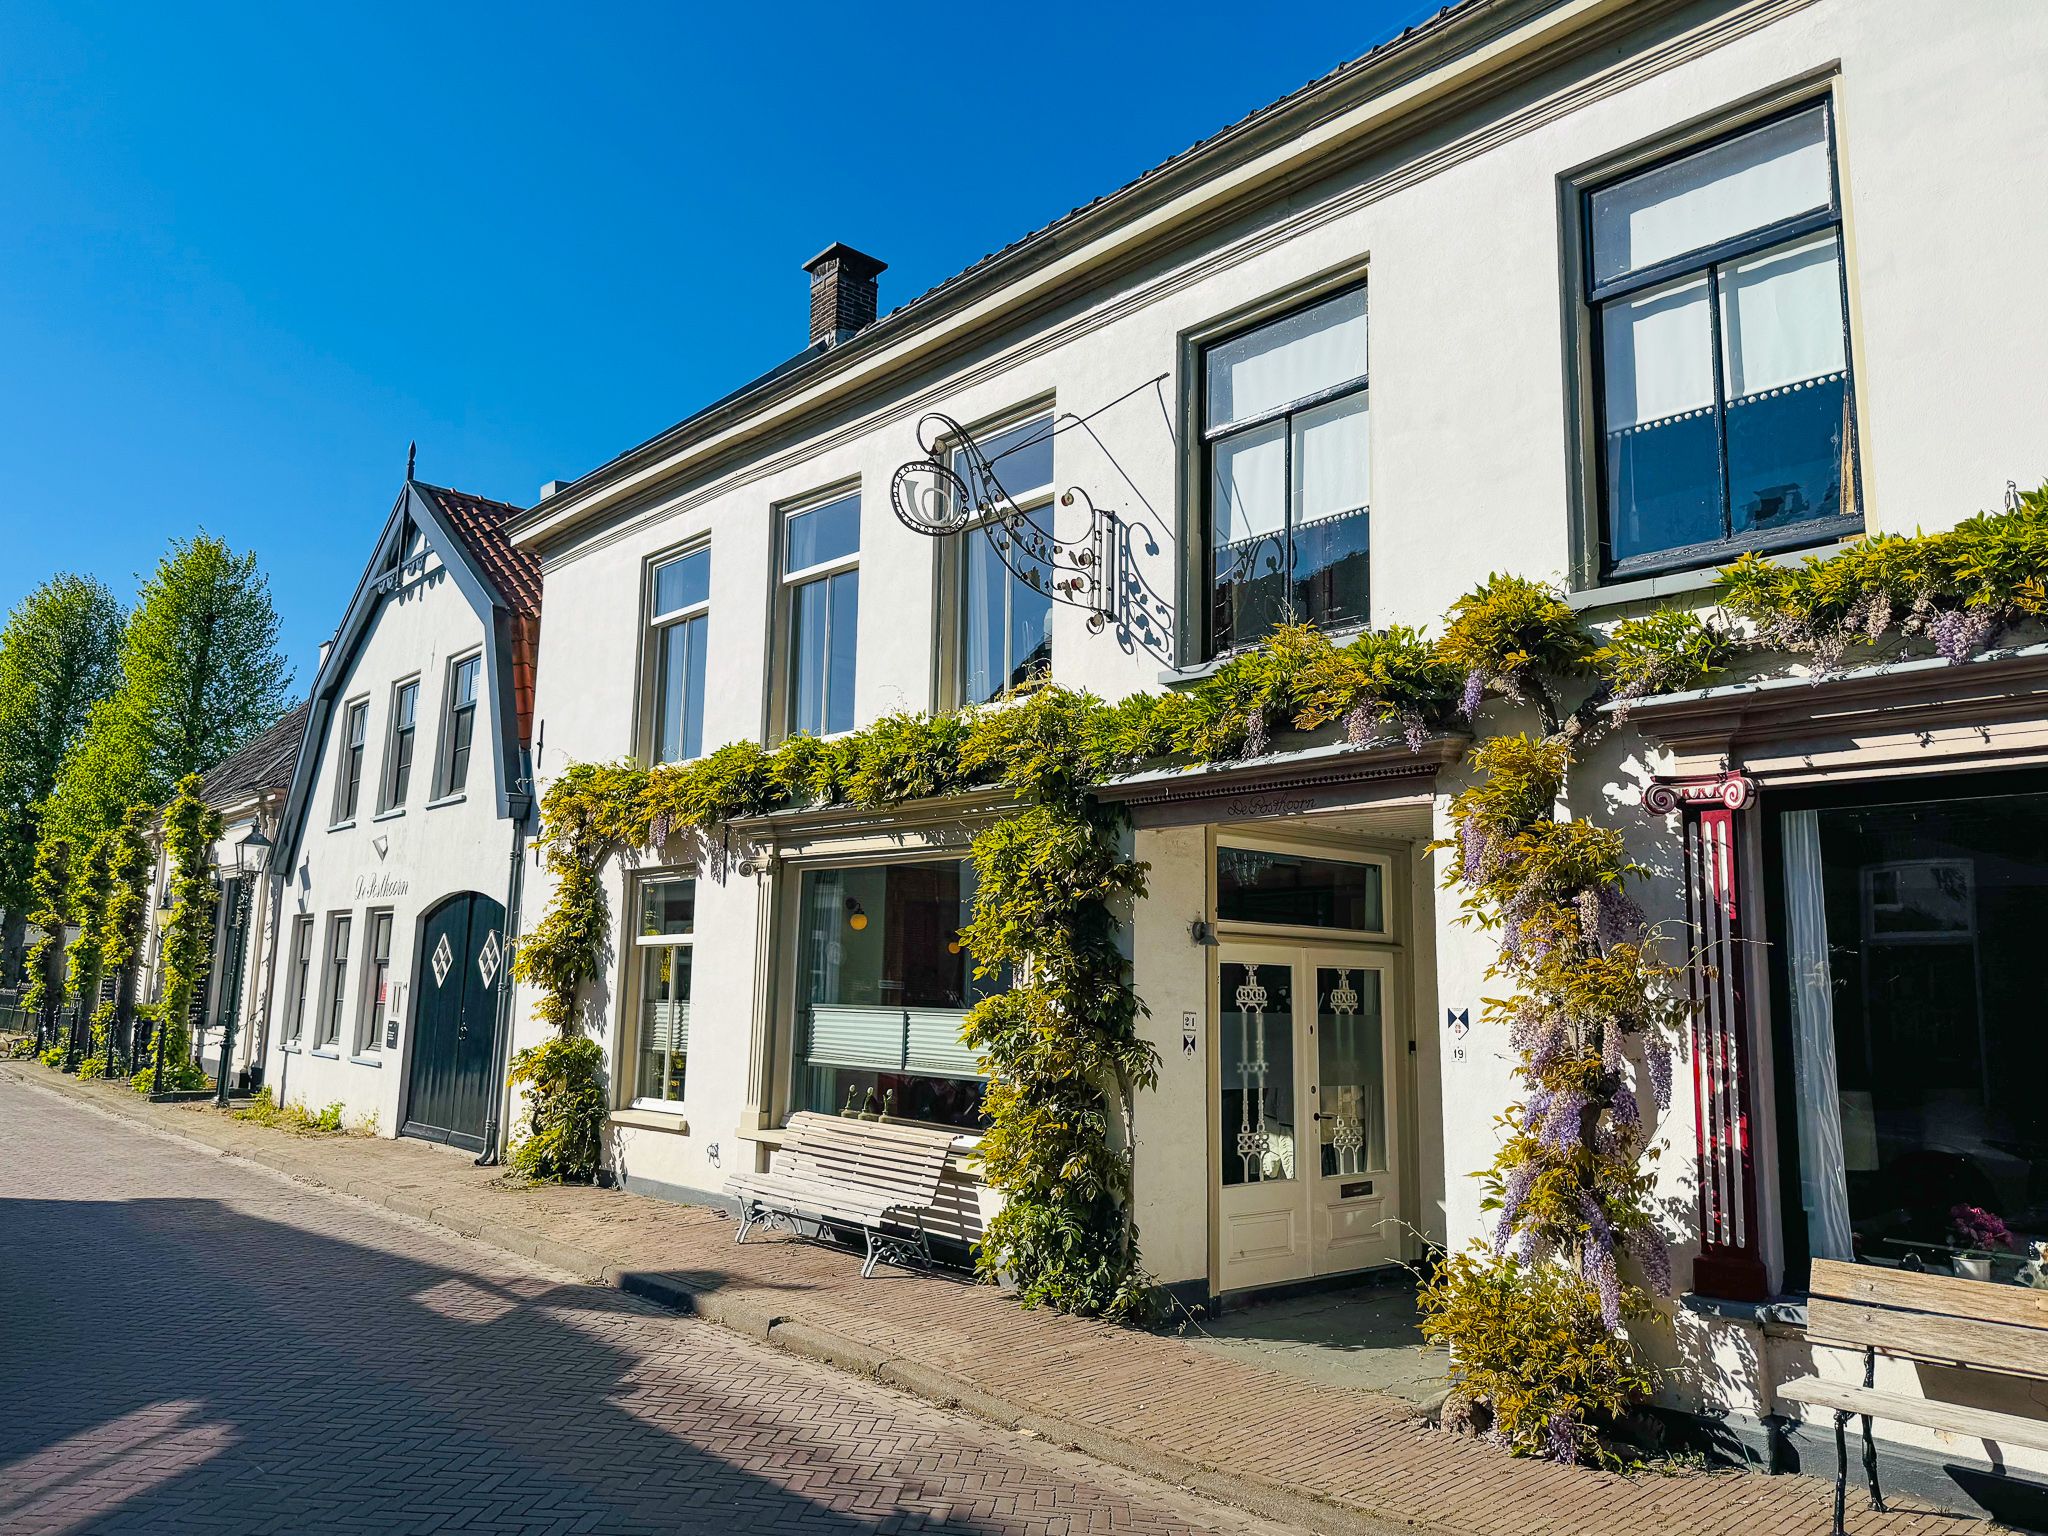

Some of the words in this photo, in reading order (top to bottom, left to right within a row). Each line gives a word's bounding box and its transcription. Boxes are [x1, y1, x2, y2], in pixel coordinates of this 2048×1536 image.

[1227, 799, 1247, 815] De
[1248, 793, 1316, 814] Posthoorn
[1184, 1016, 1195, 1027] 21
[1453, 1048, 1464, 1059] 19
